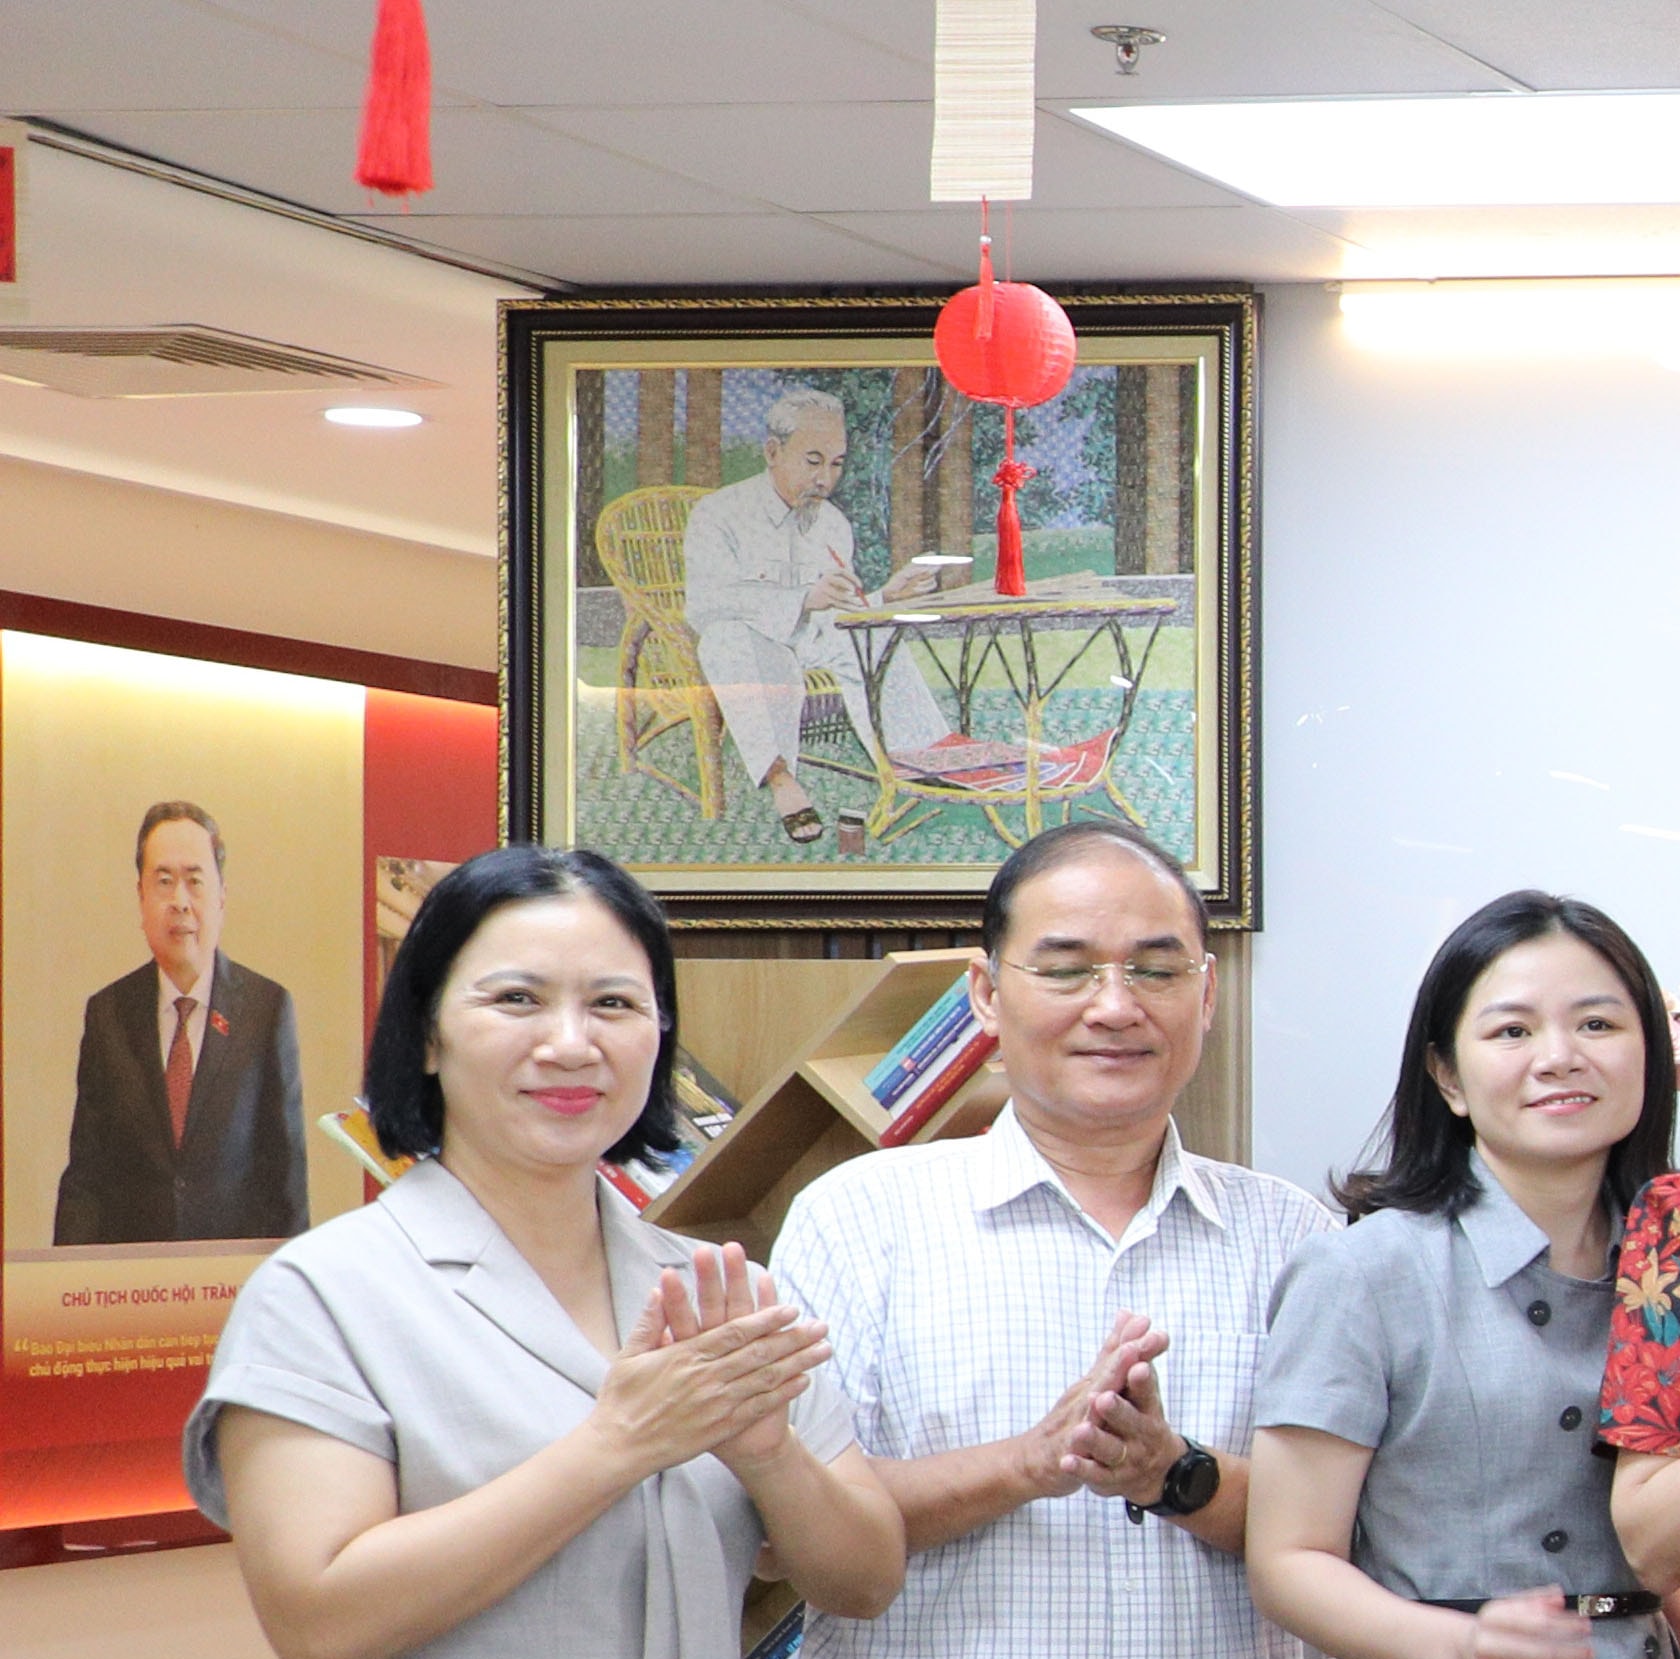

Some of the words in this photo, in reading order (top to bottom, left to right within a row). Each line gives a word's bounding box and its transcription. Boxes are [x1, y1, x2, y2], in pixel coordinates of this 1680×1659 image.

[62, 1287, 92, 1307] CHỦ
[94, 1290, 128, 1308] TỊCH
[131, 1285, 168, 1305] QUỐC
[172, 1284, 196, 1304] HỘI
